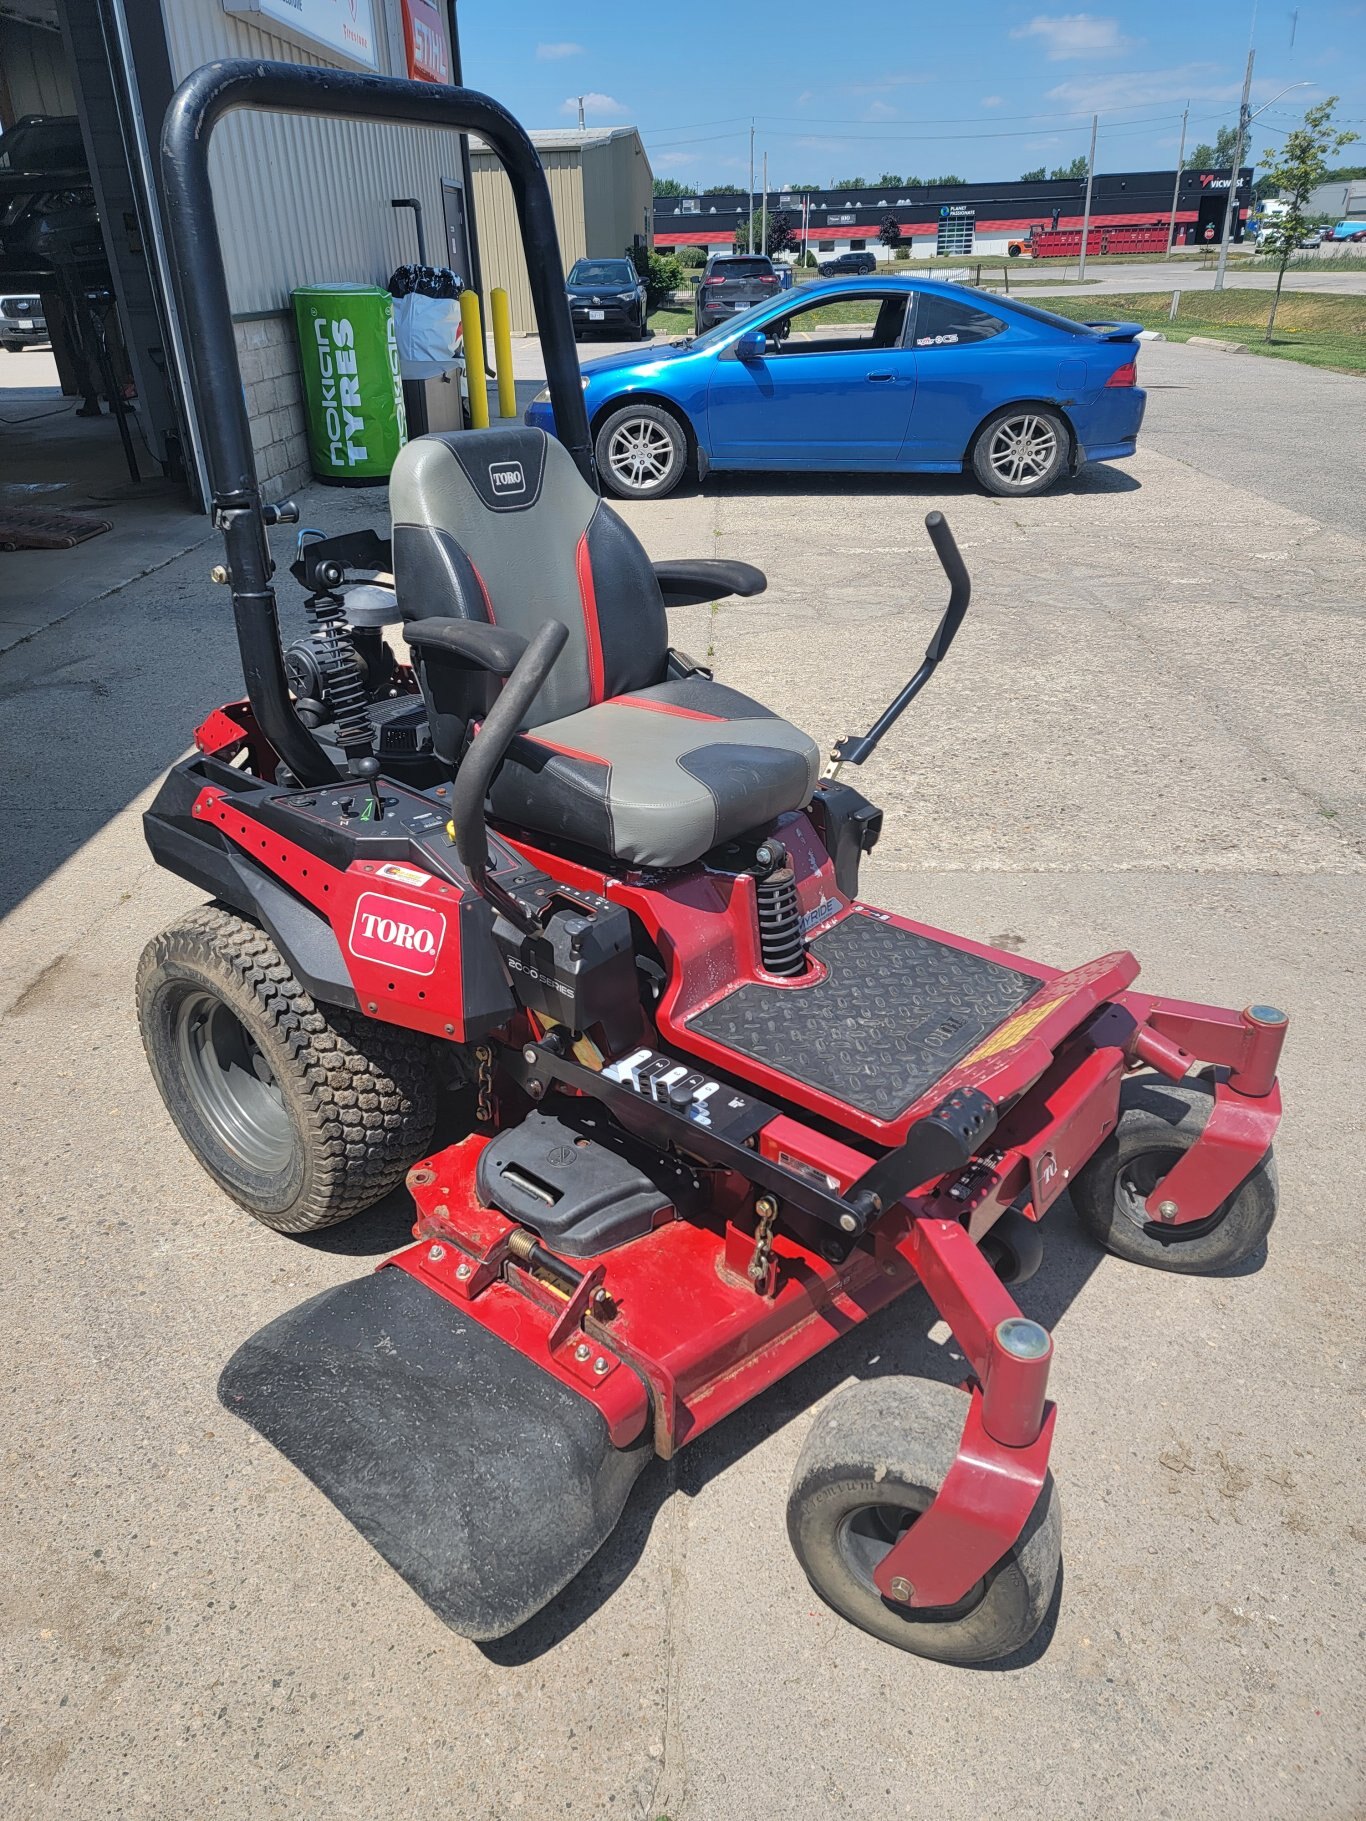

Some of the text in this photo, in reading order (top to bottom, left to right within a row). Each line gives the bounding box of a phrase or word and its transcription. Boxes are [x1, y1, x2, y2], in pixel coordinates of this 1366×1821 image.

[414, 17, 447, 76] STIHL
[1210, 178, 1244, 188] vicwst
[332, 318, 368, 467] TYRES
[493, 471, 521, 486] TORO
[361, 913, 434, 954] TORO
[508, 957, 575, 999] 2000 SERIES
